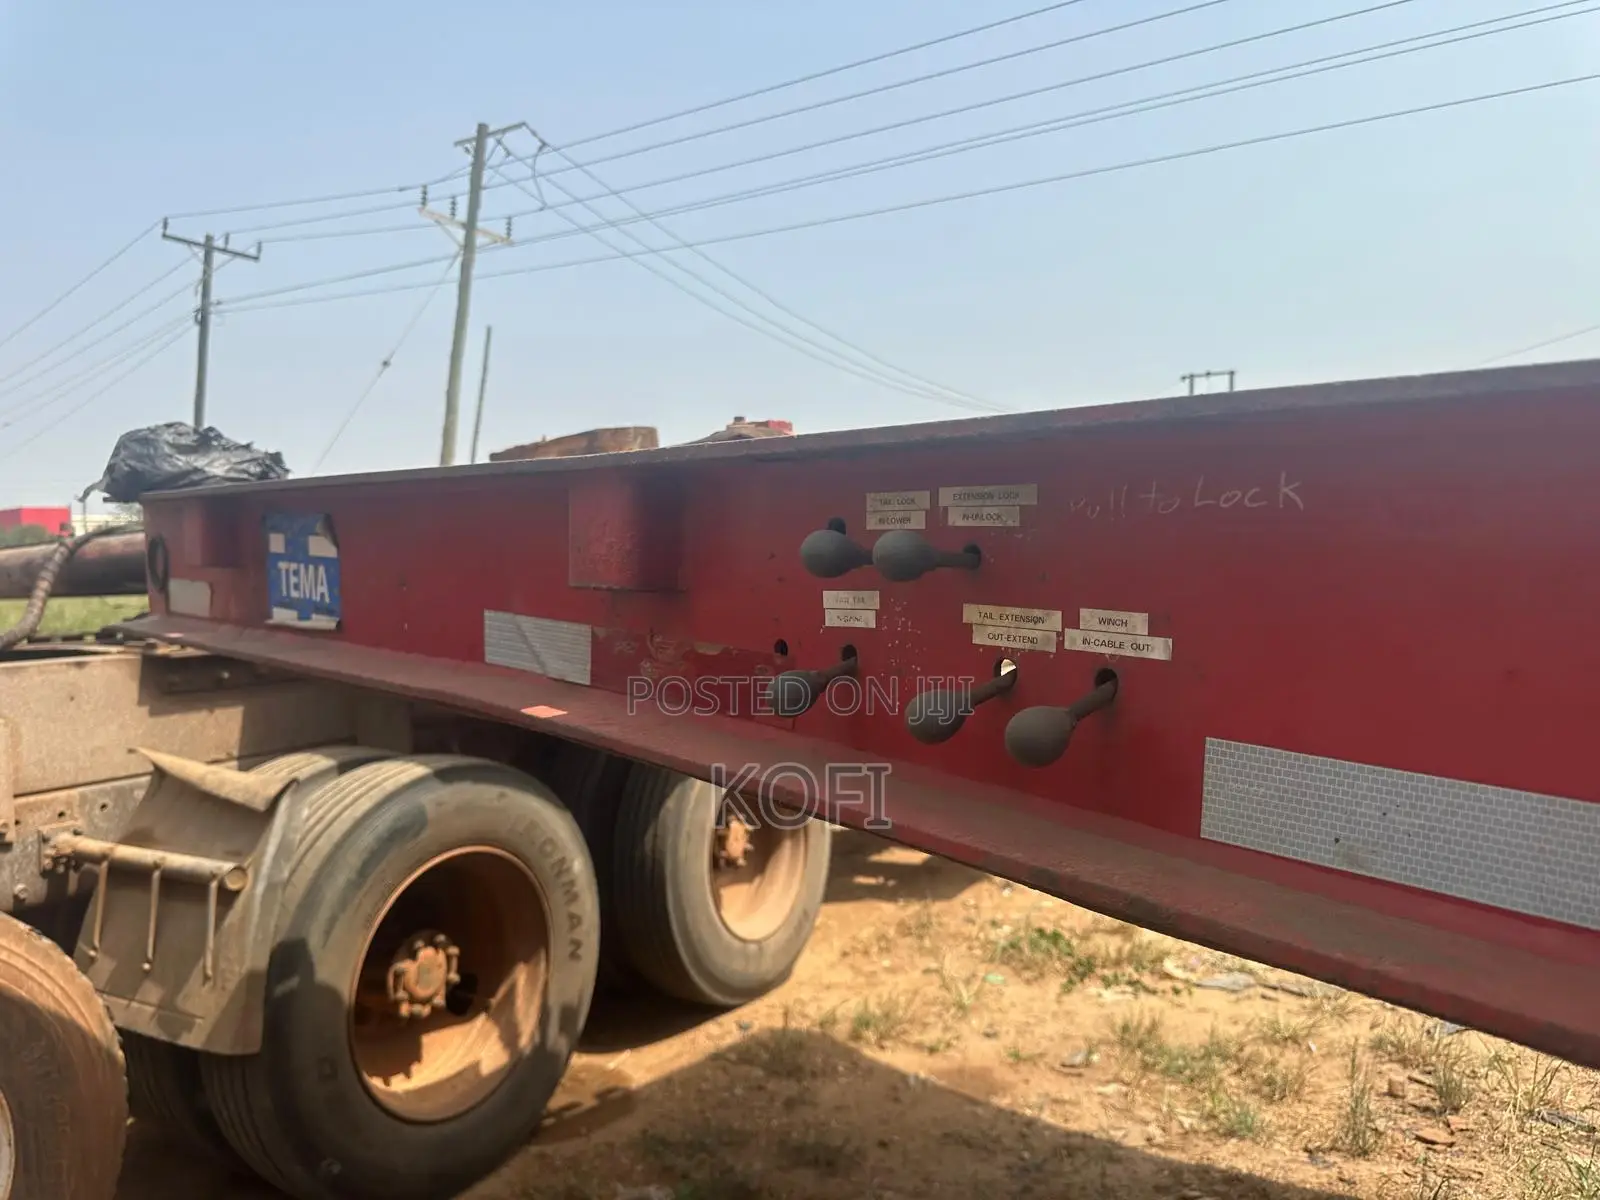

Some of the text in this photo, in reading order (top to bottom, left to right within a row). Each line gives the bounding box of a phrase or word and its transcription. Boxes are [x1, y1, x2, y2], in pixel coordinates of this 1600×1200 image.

[1138, 479, 1182, 515] to
[277, 560, 330, 604] TEMA
[978, 611, 1046, 625] TAIL EXTENSION
[1098, 616, 1128, 628] WINCH
[987, 632, 1039, 645] OUT-EXTEND
[1082, 636, 1151, 653] IN-CABLE OUT
